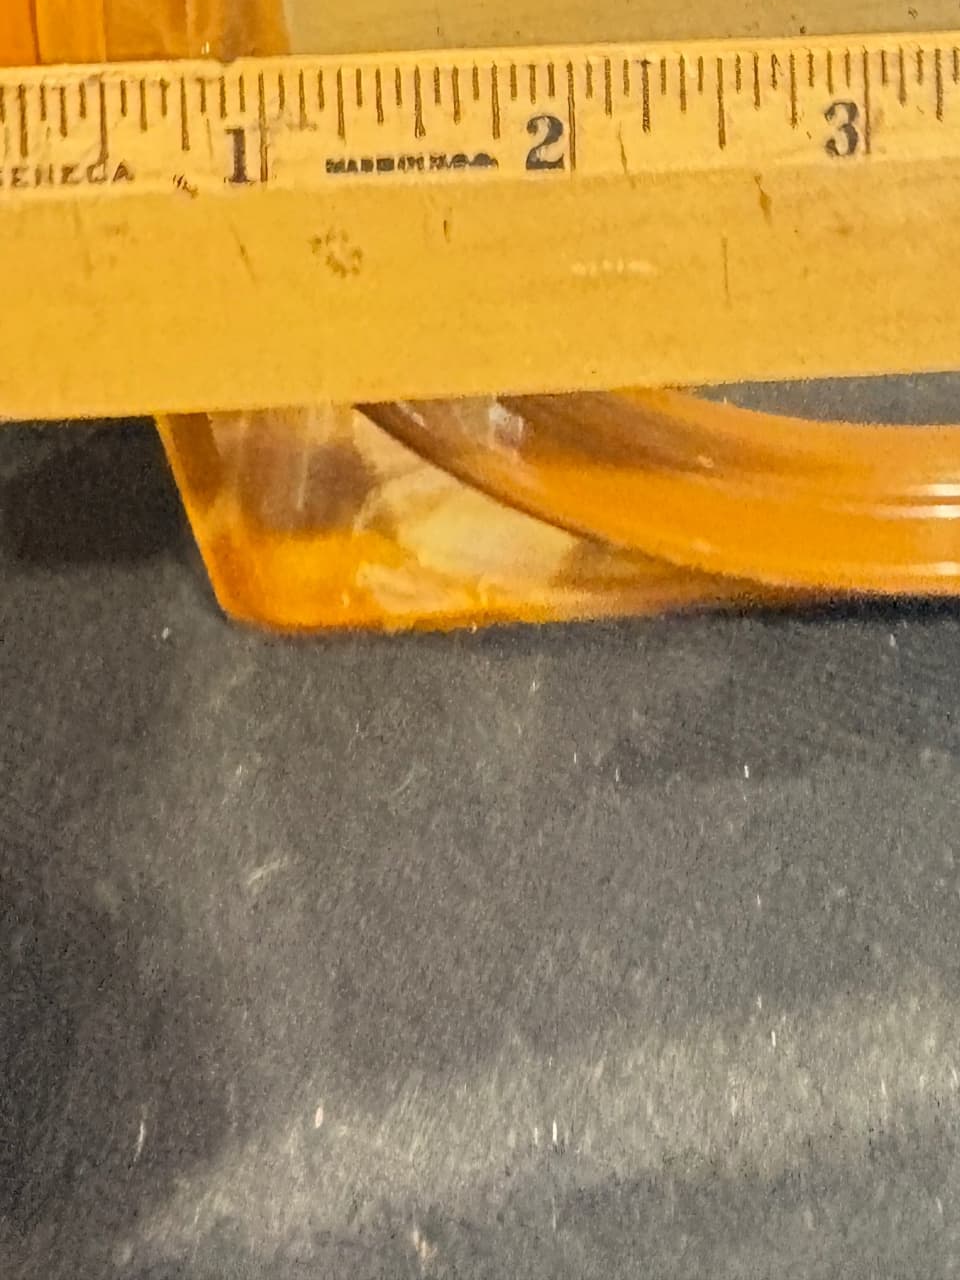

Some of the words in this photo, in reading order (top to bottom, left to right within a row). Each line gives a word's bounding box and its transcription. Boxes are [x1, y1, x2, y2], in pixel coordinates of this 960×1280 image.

[223, 128, 256, 184] 1
[525, 114, 565, 171] 2
[823, 100, 860, 158] 3
